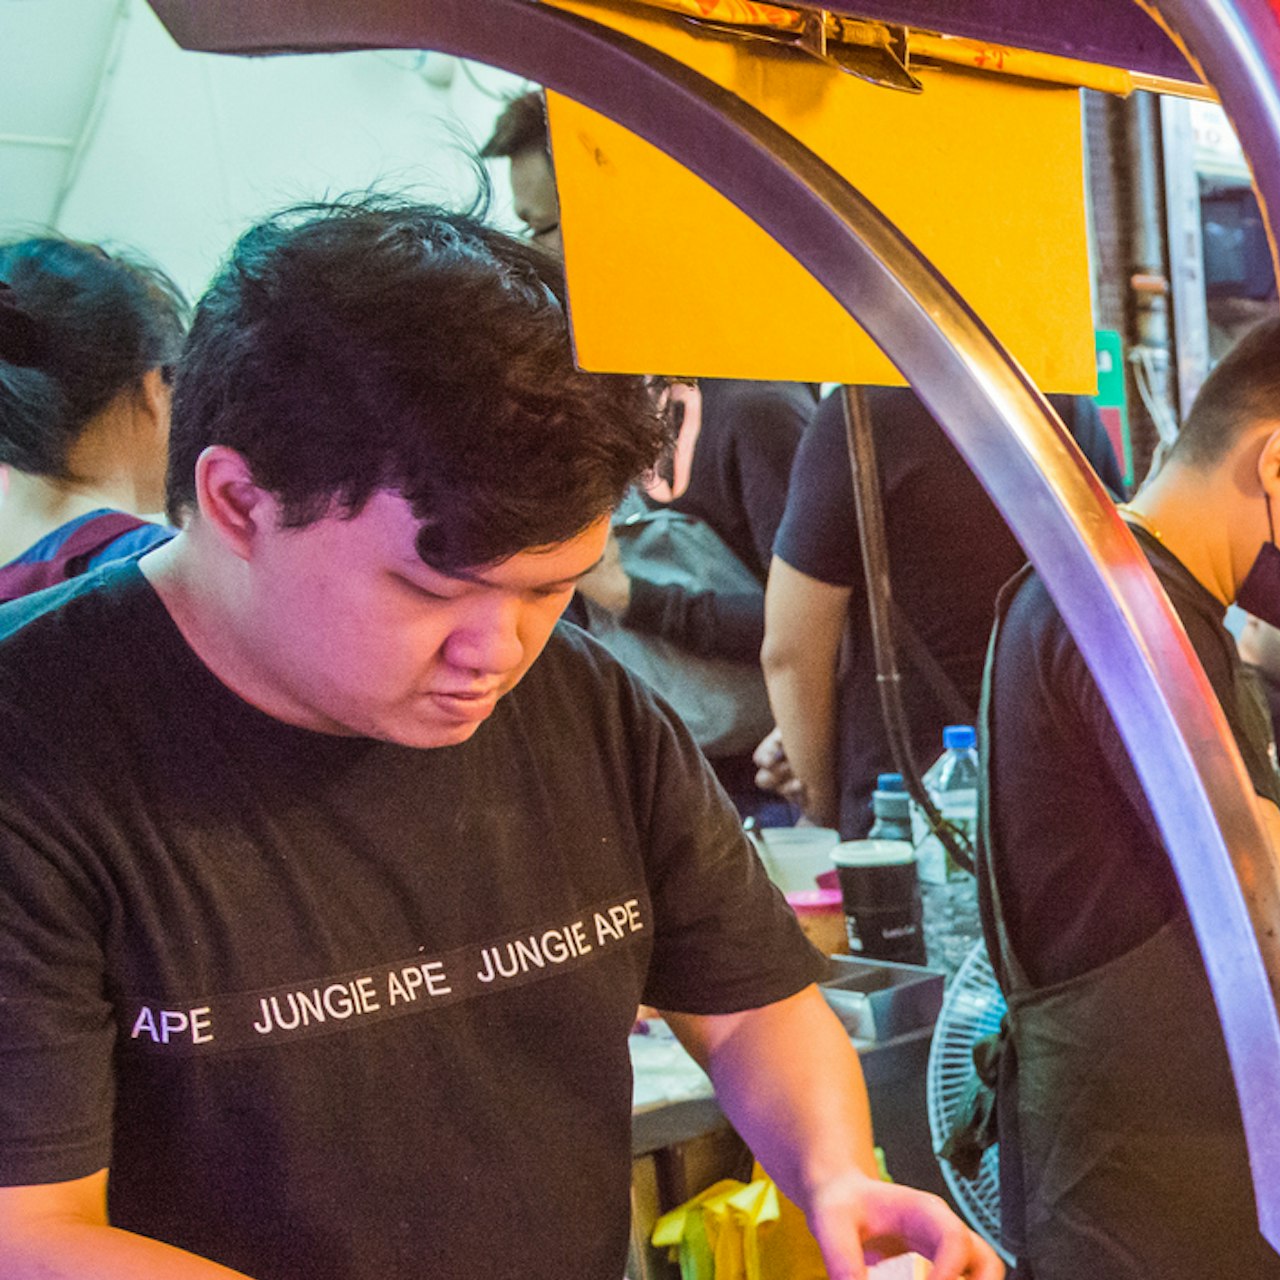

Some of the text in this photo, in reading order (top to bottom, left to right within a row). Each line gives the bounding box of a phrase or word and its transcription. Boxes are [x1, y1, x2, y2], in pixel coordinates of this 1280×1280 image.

[130, 898, 644, 1045] APE JUNGIE APE JUNGIE APE
